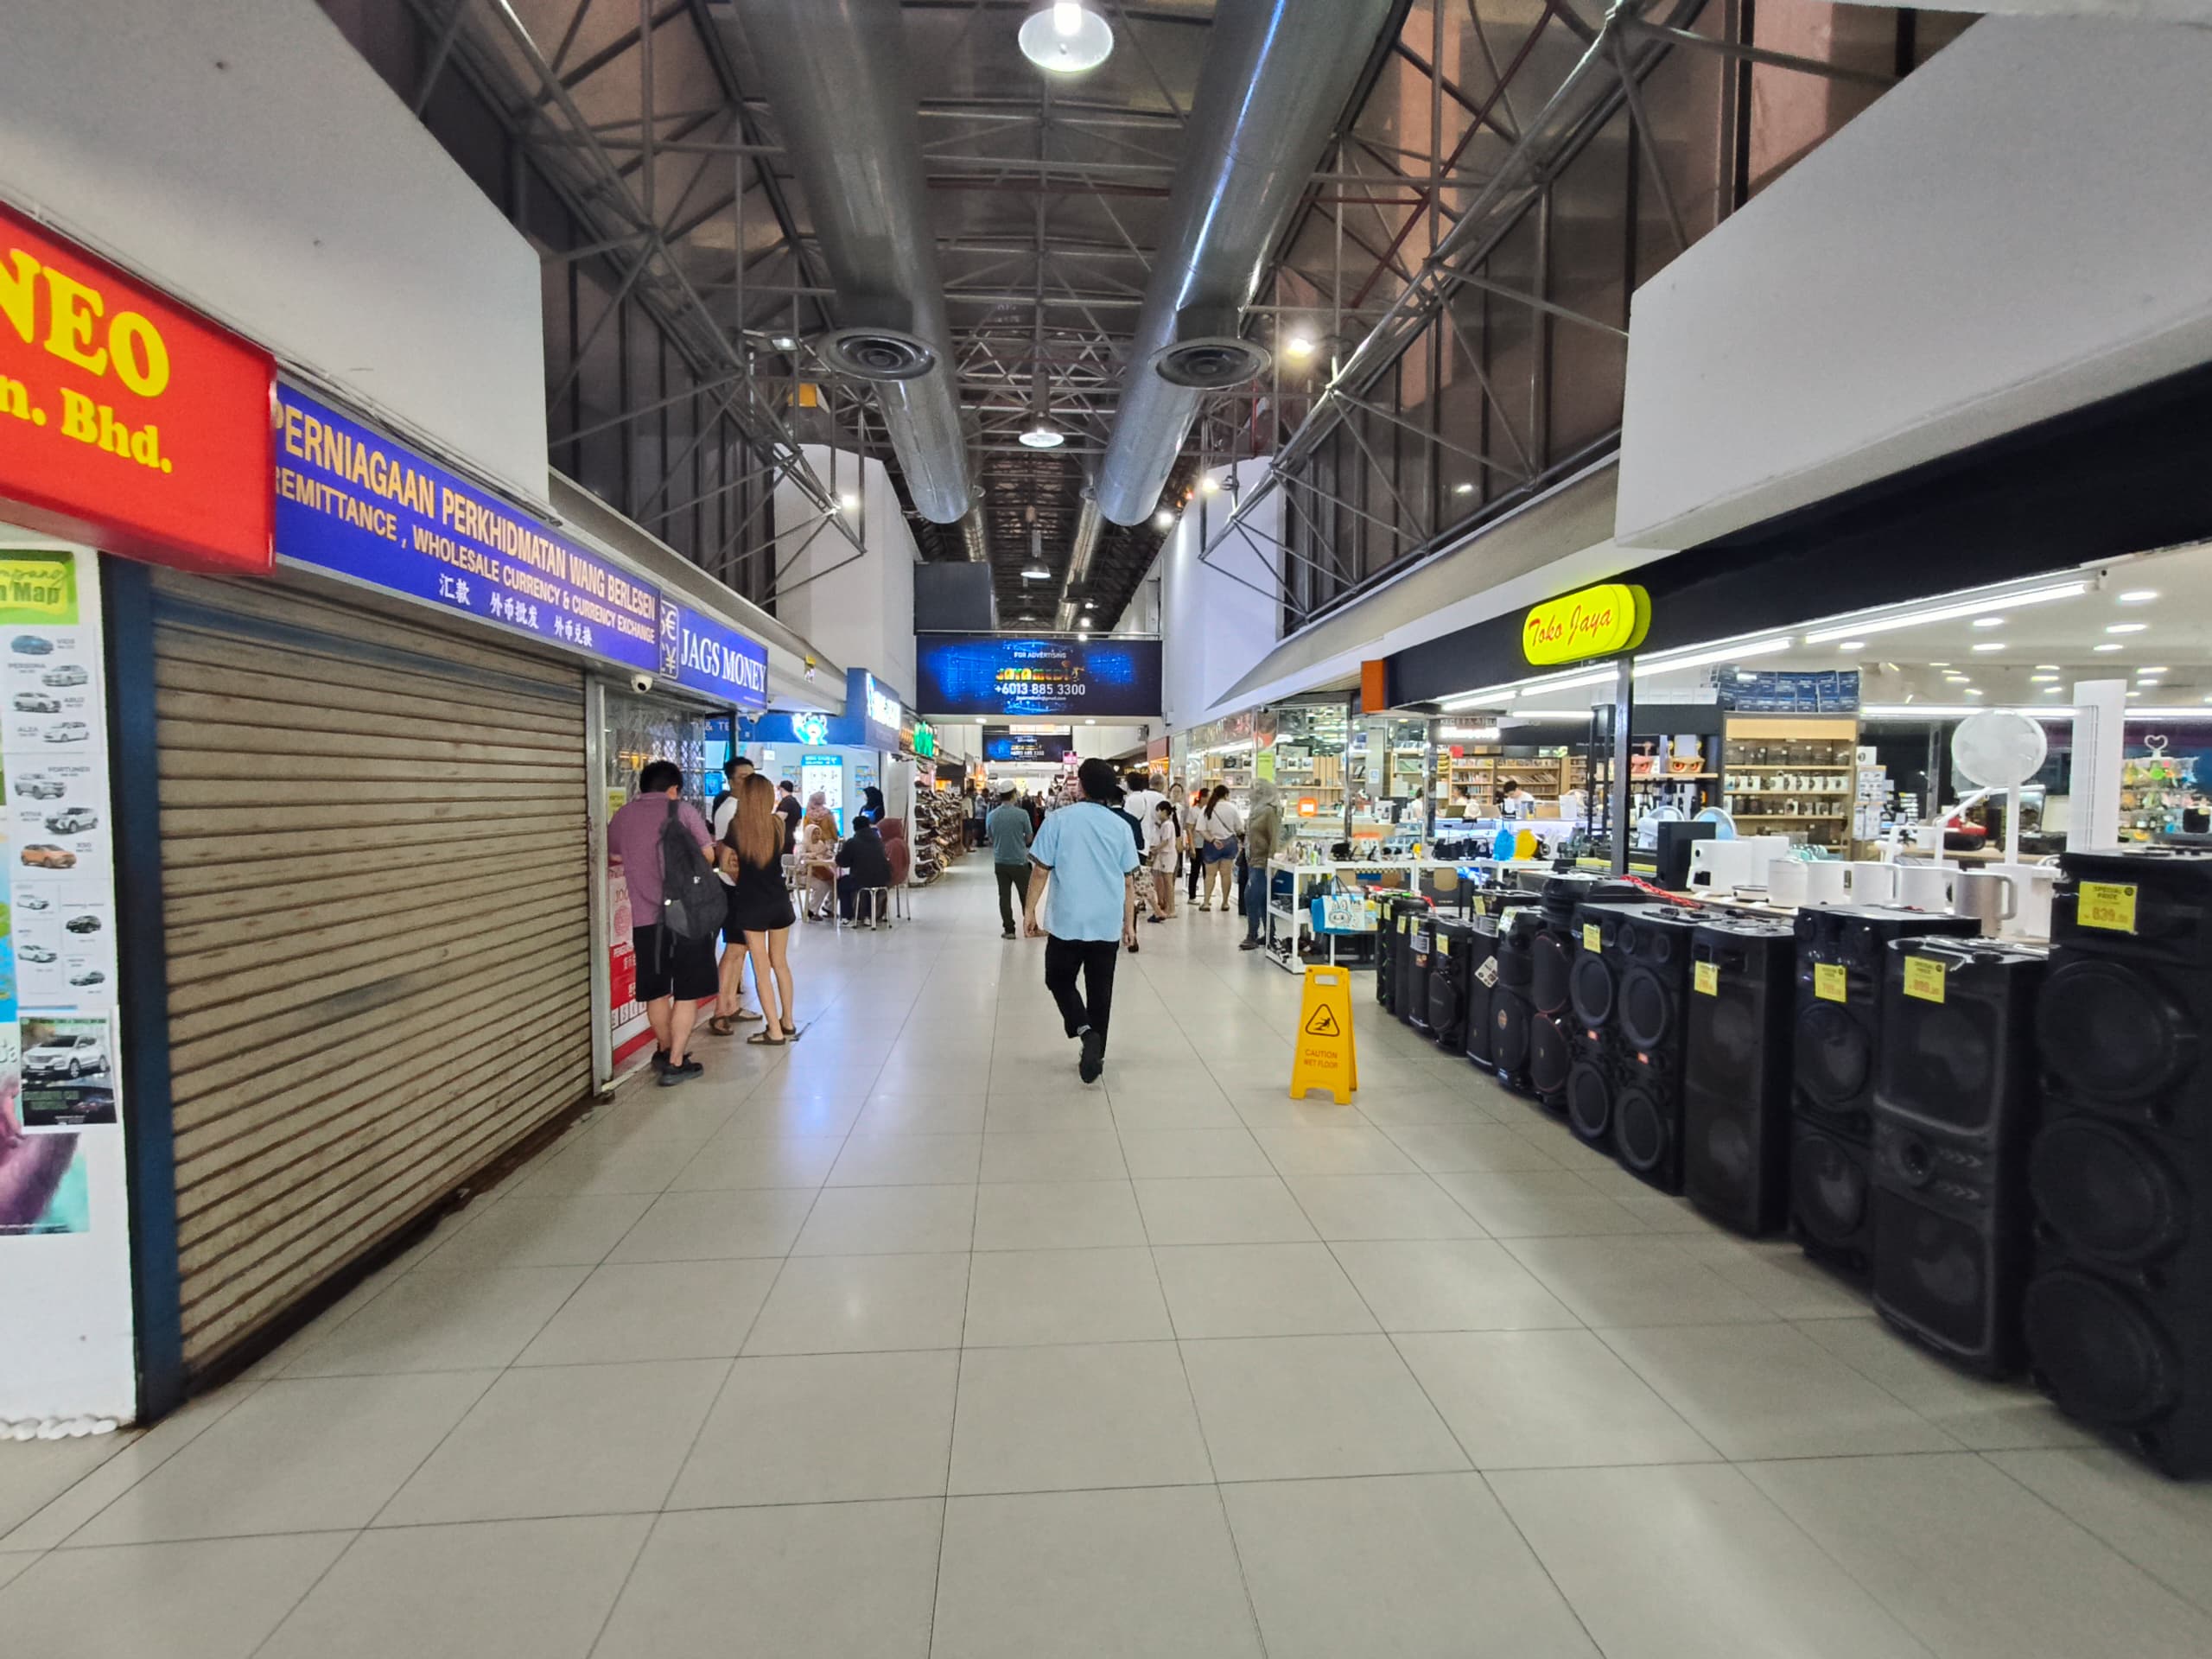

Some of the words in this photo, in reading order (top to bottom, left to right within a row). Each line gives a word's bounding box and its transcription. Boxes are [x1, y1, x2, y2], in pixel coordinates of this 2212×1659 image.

[60, 387, 172, 474] Bhd.
[442, 487, 566, 580] PERKHIDMATAN
[570, 553, 605, 598] WANG
[608, 574, 655, 620] BERLESEN
[14, 581, 60, 605] Map
[412, 524, 499, 583] WHOLESALE
[503, 565, 561, 607] CURRENCY
[563, 591, 570, 610] &
[572, 594, 616, 628] CURRENCY
[618, 614, 655, 645] EXCHANGE
[439, 573, 471, 606] 汇款
[490, 591, 540, 630] 外币批发
[554, 614, 594, 648] 外币兑换
[1529, 615, 1563, 646] Toko
[1567, 605, 1611, 646] Jaya
[681, 628, 720, 677] JAGS
[721, 646, 767, 693] MONEY
[995, 683, 1028, 696] +6013
[1032, 683, 1054, 696] 885
[1057, 683, 1086, 696] 3300
[1303, 1058, 1317, 1067] WET
[1317, 1059, 1338, 1070] FLOOR
[1305, 1049, 1338, 1059] CAUTION
